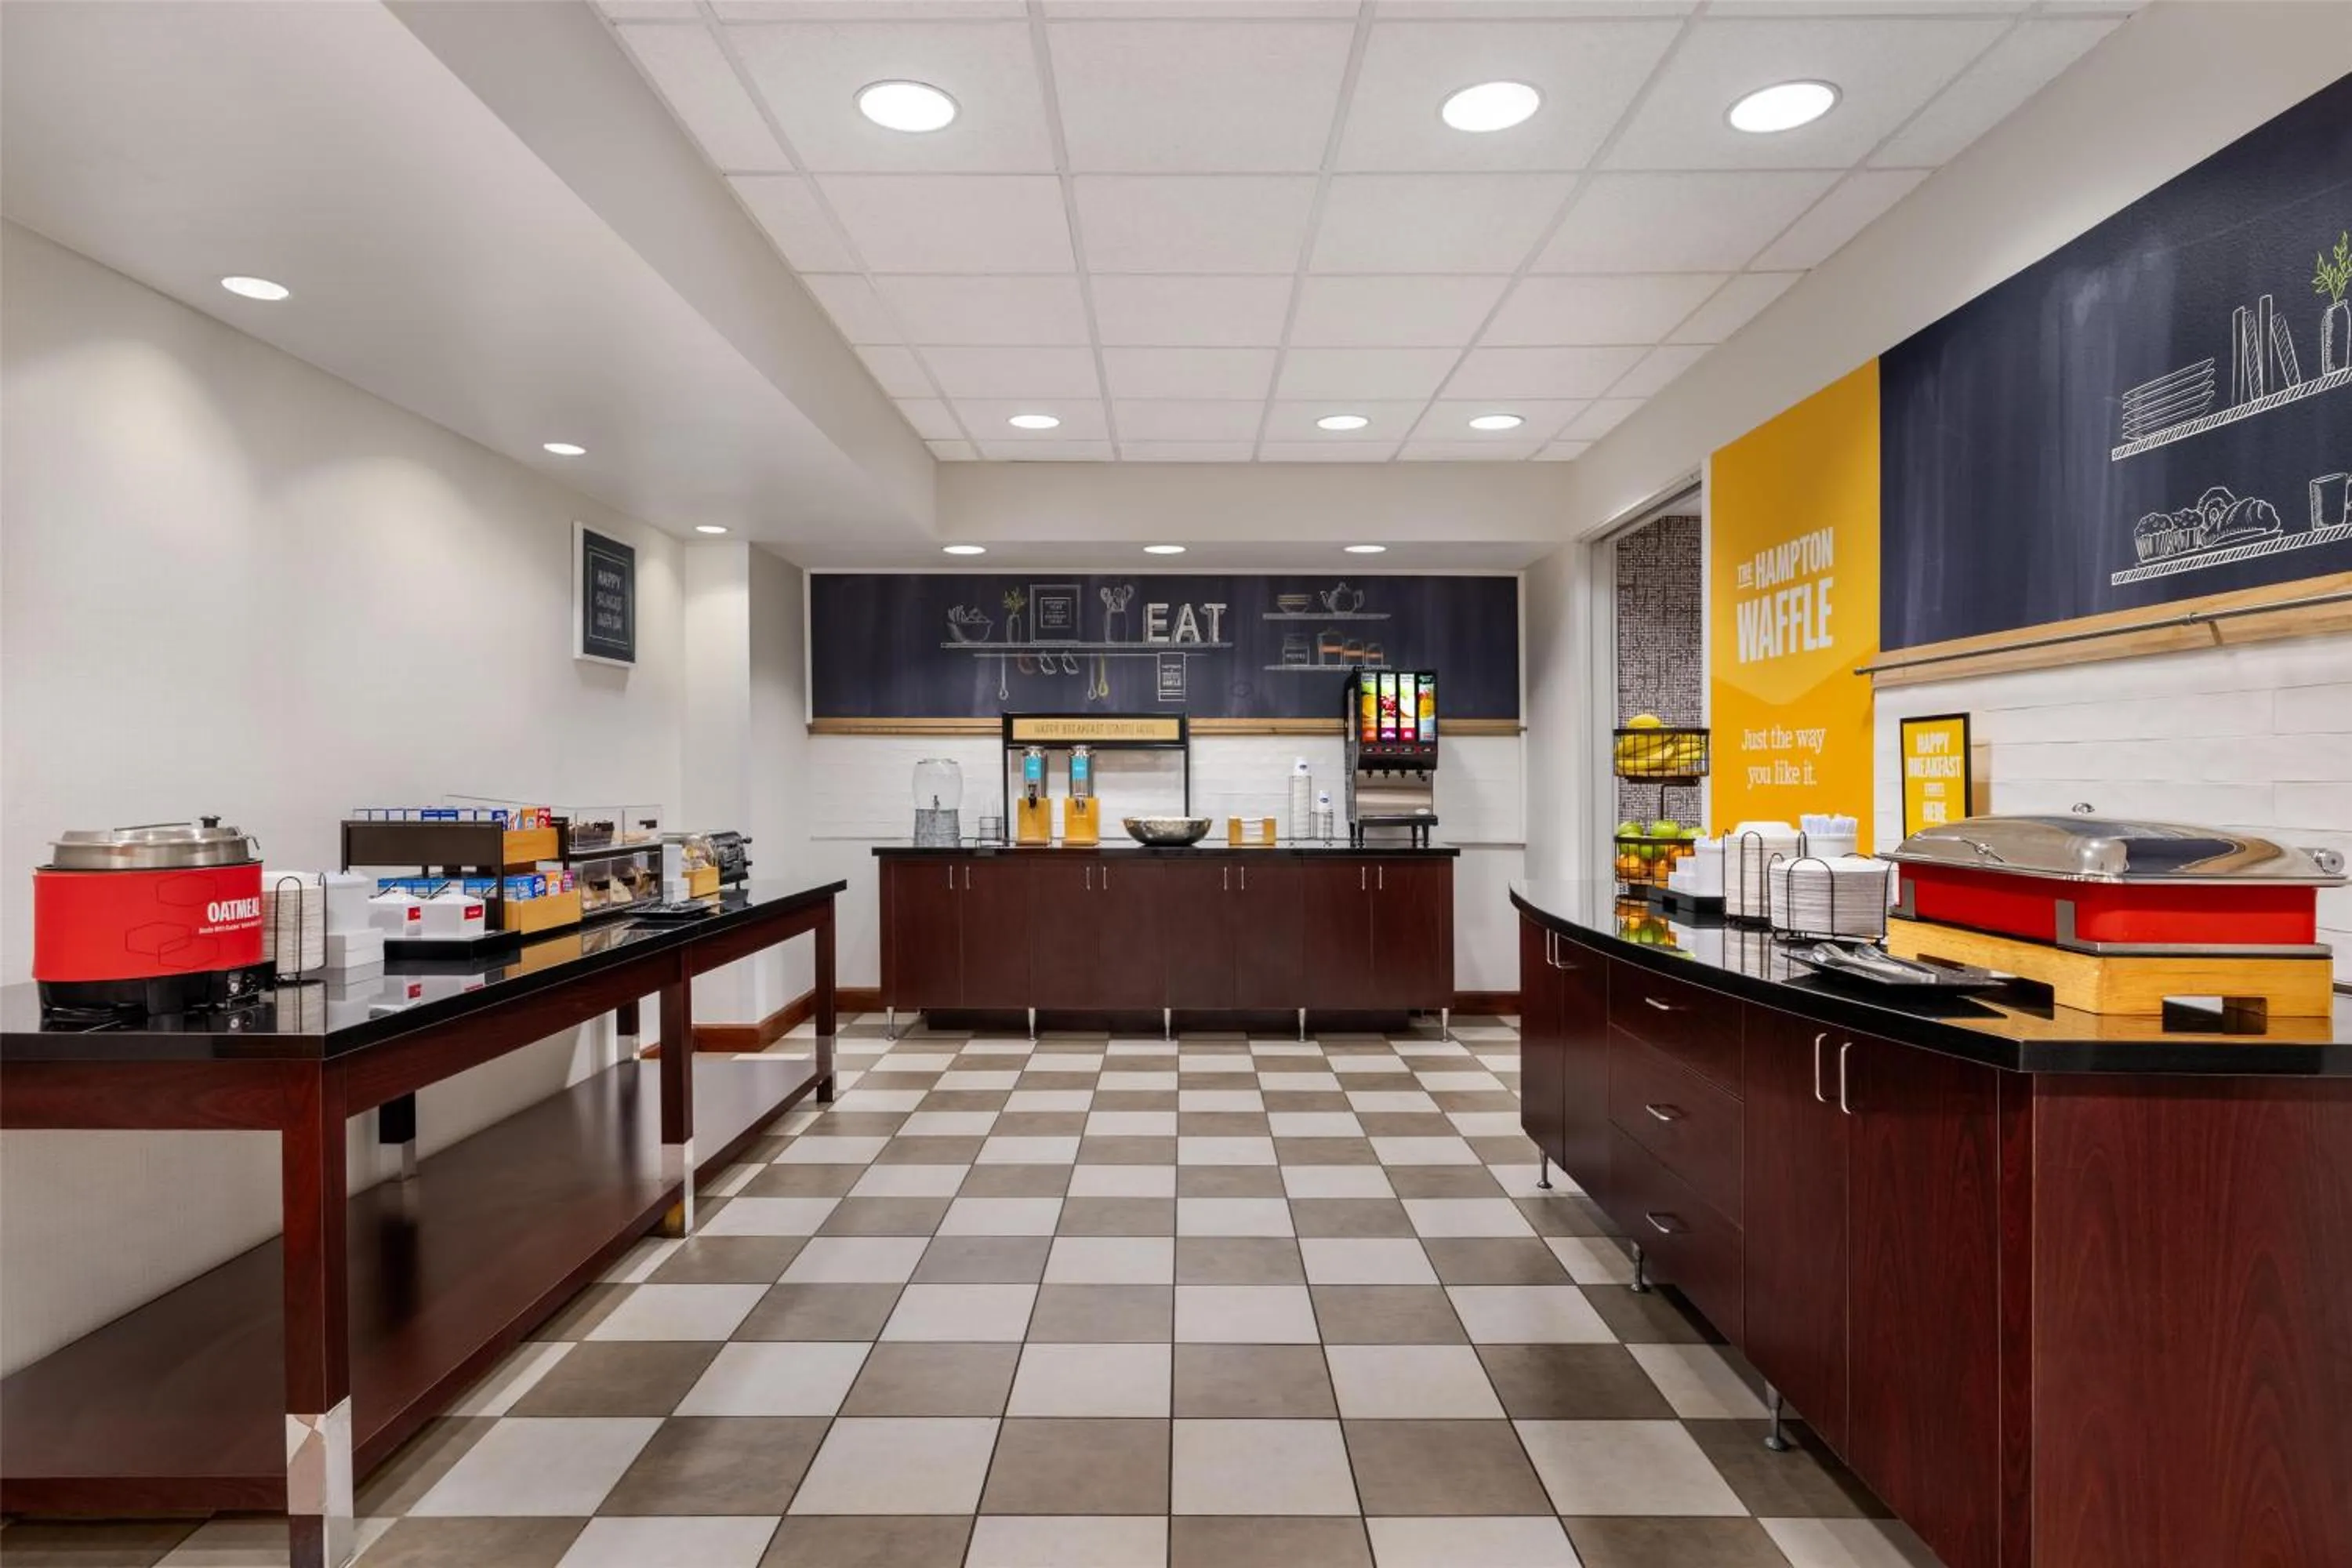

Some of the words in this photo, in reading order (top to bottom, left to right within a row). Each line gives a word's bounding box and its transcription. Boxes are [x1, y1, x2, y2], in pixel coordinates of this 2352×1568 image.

[1737, 561, 1754, 587] THE
[1755, 526, 1834, 590] HAMPTON
[1143, 602, 1227, 643] EAT
[1737, 576, 1834, 664] WAFFLE
[1741, 728, 1768, 751] Just
[1770, 724, 1793, 749] the
[1795, 728, 1827, 754] way
[1916, 731, 1951, 753] HAPPY
[1746, 766, 1771, 790] you
[1774, 759, 1801, 785] like
[1907, 755, 1964, 778] BREAKFAST
